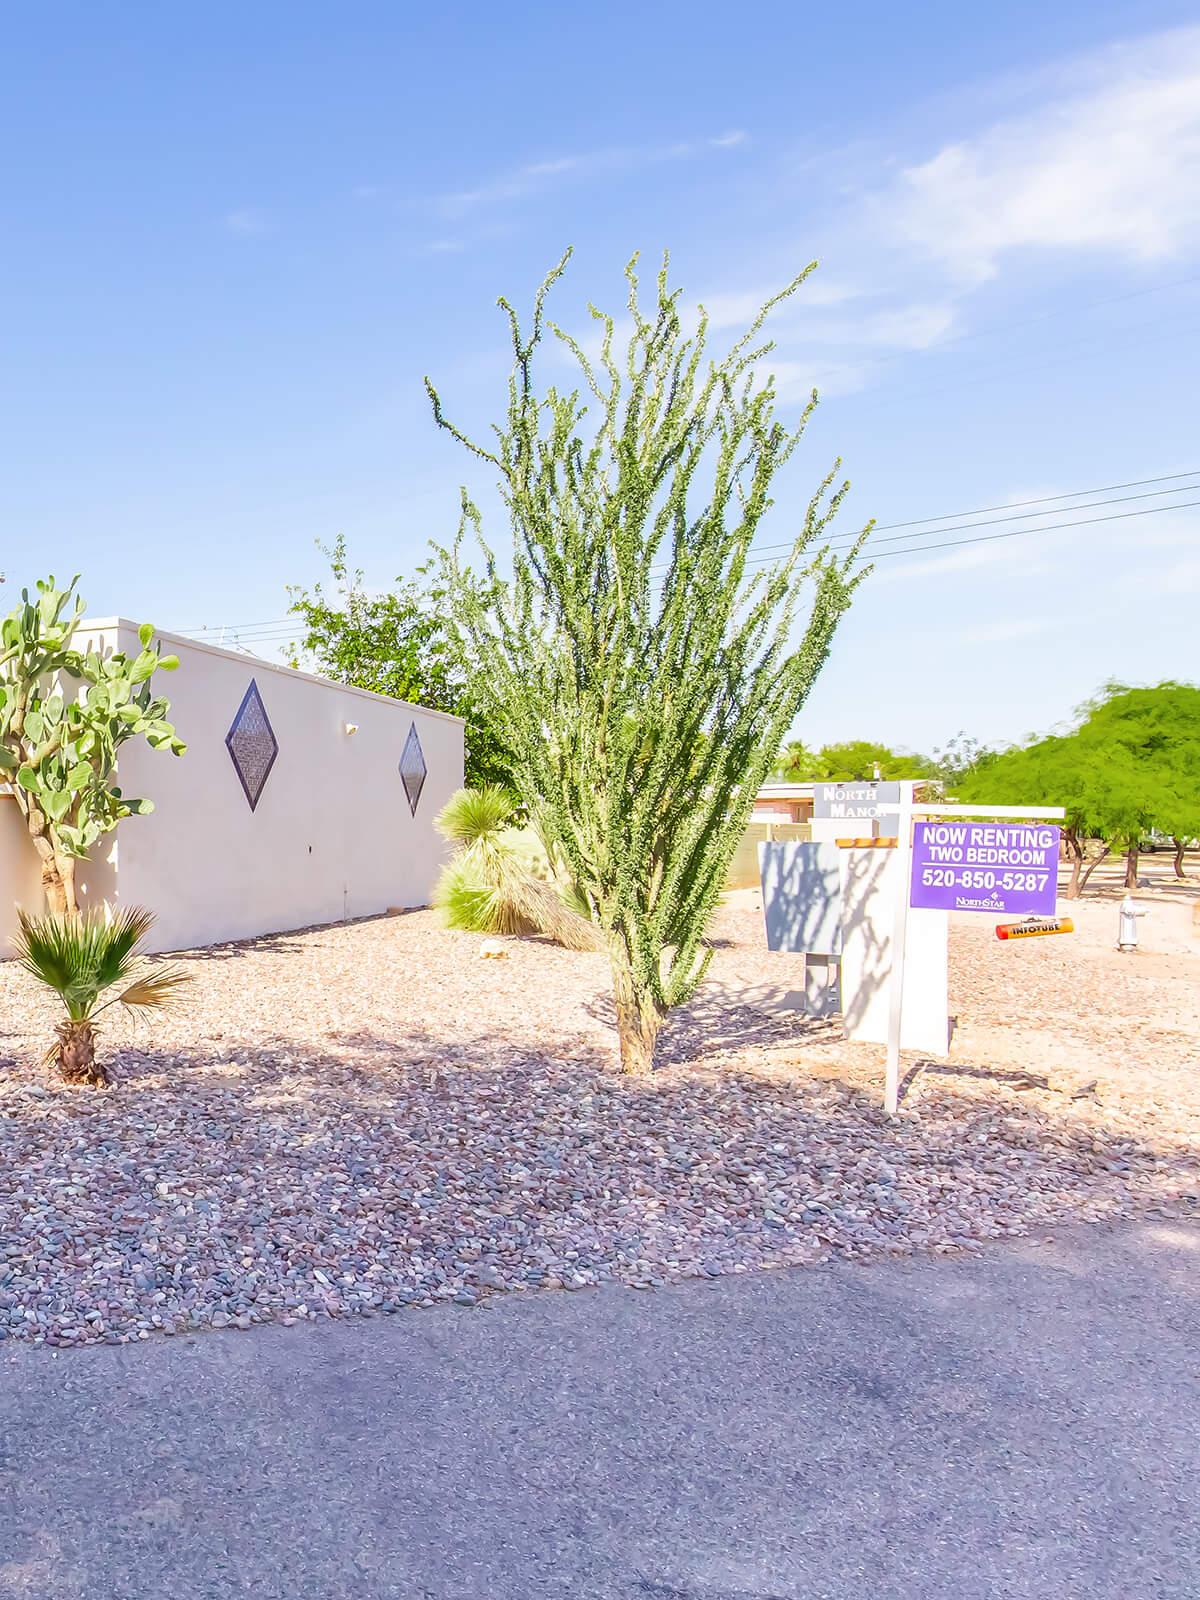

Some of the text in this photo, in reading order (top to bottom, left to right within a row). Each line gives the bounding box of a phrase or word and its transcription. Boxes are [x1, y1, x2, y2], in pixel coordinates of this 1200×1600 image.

[823, 786, 878, 801] NORTH
[923, 827, 1053, 849] NOW RENTING
[929, 846, 1046, 865] TWO BEDROOM
[922, 869, 1049, 892] 520-850-5287
